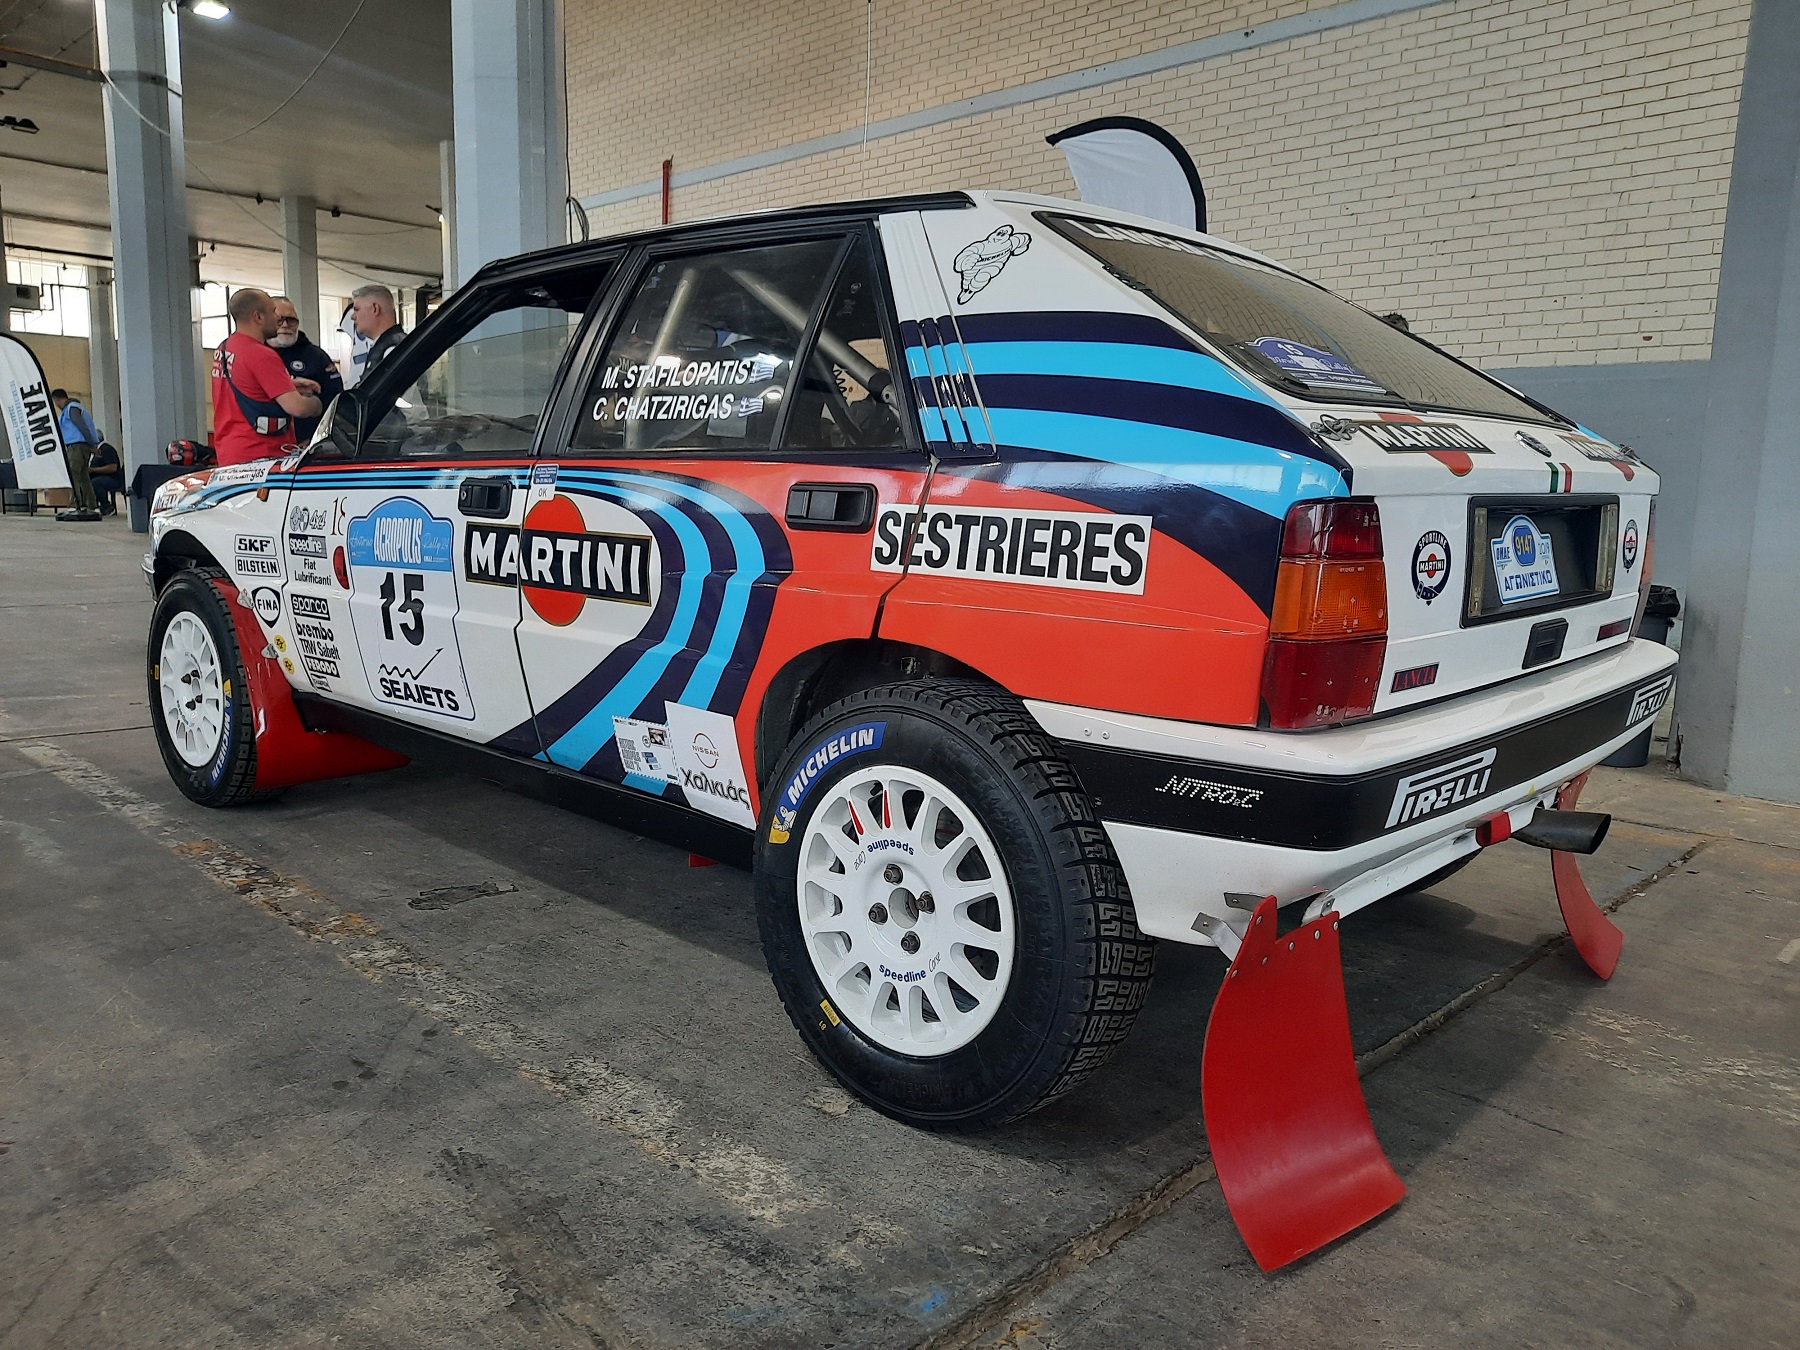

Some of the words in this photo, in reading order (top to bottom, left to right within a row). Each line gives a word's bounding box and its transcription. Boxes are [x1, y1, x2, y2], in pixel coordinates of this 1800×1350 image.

[1277, 343, 1304, 355] 15
[601, 366, 619, 389] M.
[623, 359, 751, 389] STAFILOPATIS
[592, 396, 609, 422] C.
[613, 392, 735, 421] CHATZIRIGAS
[1358, 424, 1486, 450] MARTINI
[238, 538, 271, 552] SKF
[373, 516, 424, 565] ACROPOLIS
[873, 510, 1146, 587] SESTRIERES
[1419, 532, 1448, 550] SPORTLINE
[1515, 534, 1533, 555] 9147
[237, 559, 279, 575] BILSTEIN
[303, 558, 317, 571] Fiat
[470, 530, 641, 595] MARTINI
[1420, 560, 1444, 572] MARTINI
[294, 569, 333, 587] Lubrificanti
[1504, 569, 1554, 592] ΑΓΩΝΙΣΤΙΚΟ
[257, 598, 279, 612] FINA
[293, 596, 328, 616] sparco
[379, 571, 425, 647] 15
[294, 617, 335, 642] brembo
[306, 657, 338, 675] FERODO
[1393, 666, 1436, 692] LANCIA
[379, 677, 460, 712] SEAJETS
[1625, 674, 1673, 727] PIRELLI
[210, 711, 231, 781] MICHELIN
[692, 745, 719, 758] NISSAN
[787, 728, 875, 806] MICHELIN
[680, 766, 751, 811] Χαλκιάς
[1384, 747, 1498, 830] PIRELLI
[867, 838, 915, 856] speedline
[878, 963, 927, 983] speedline
